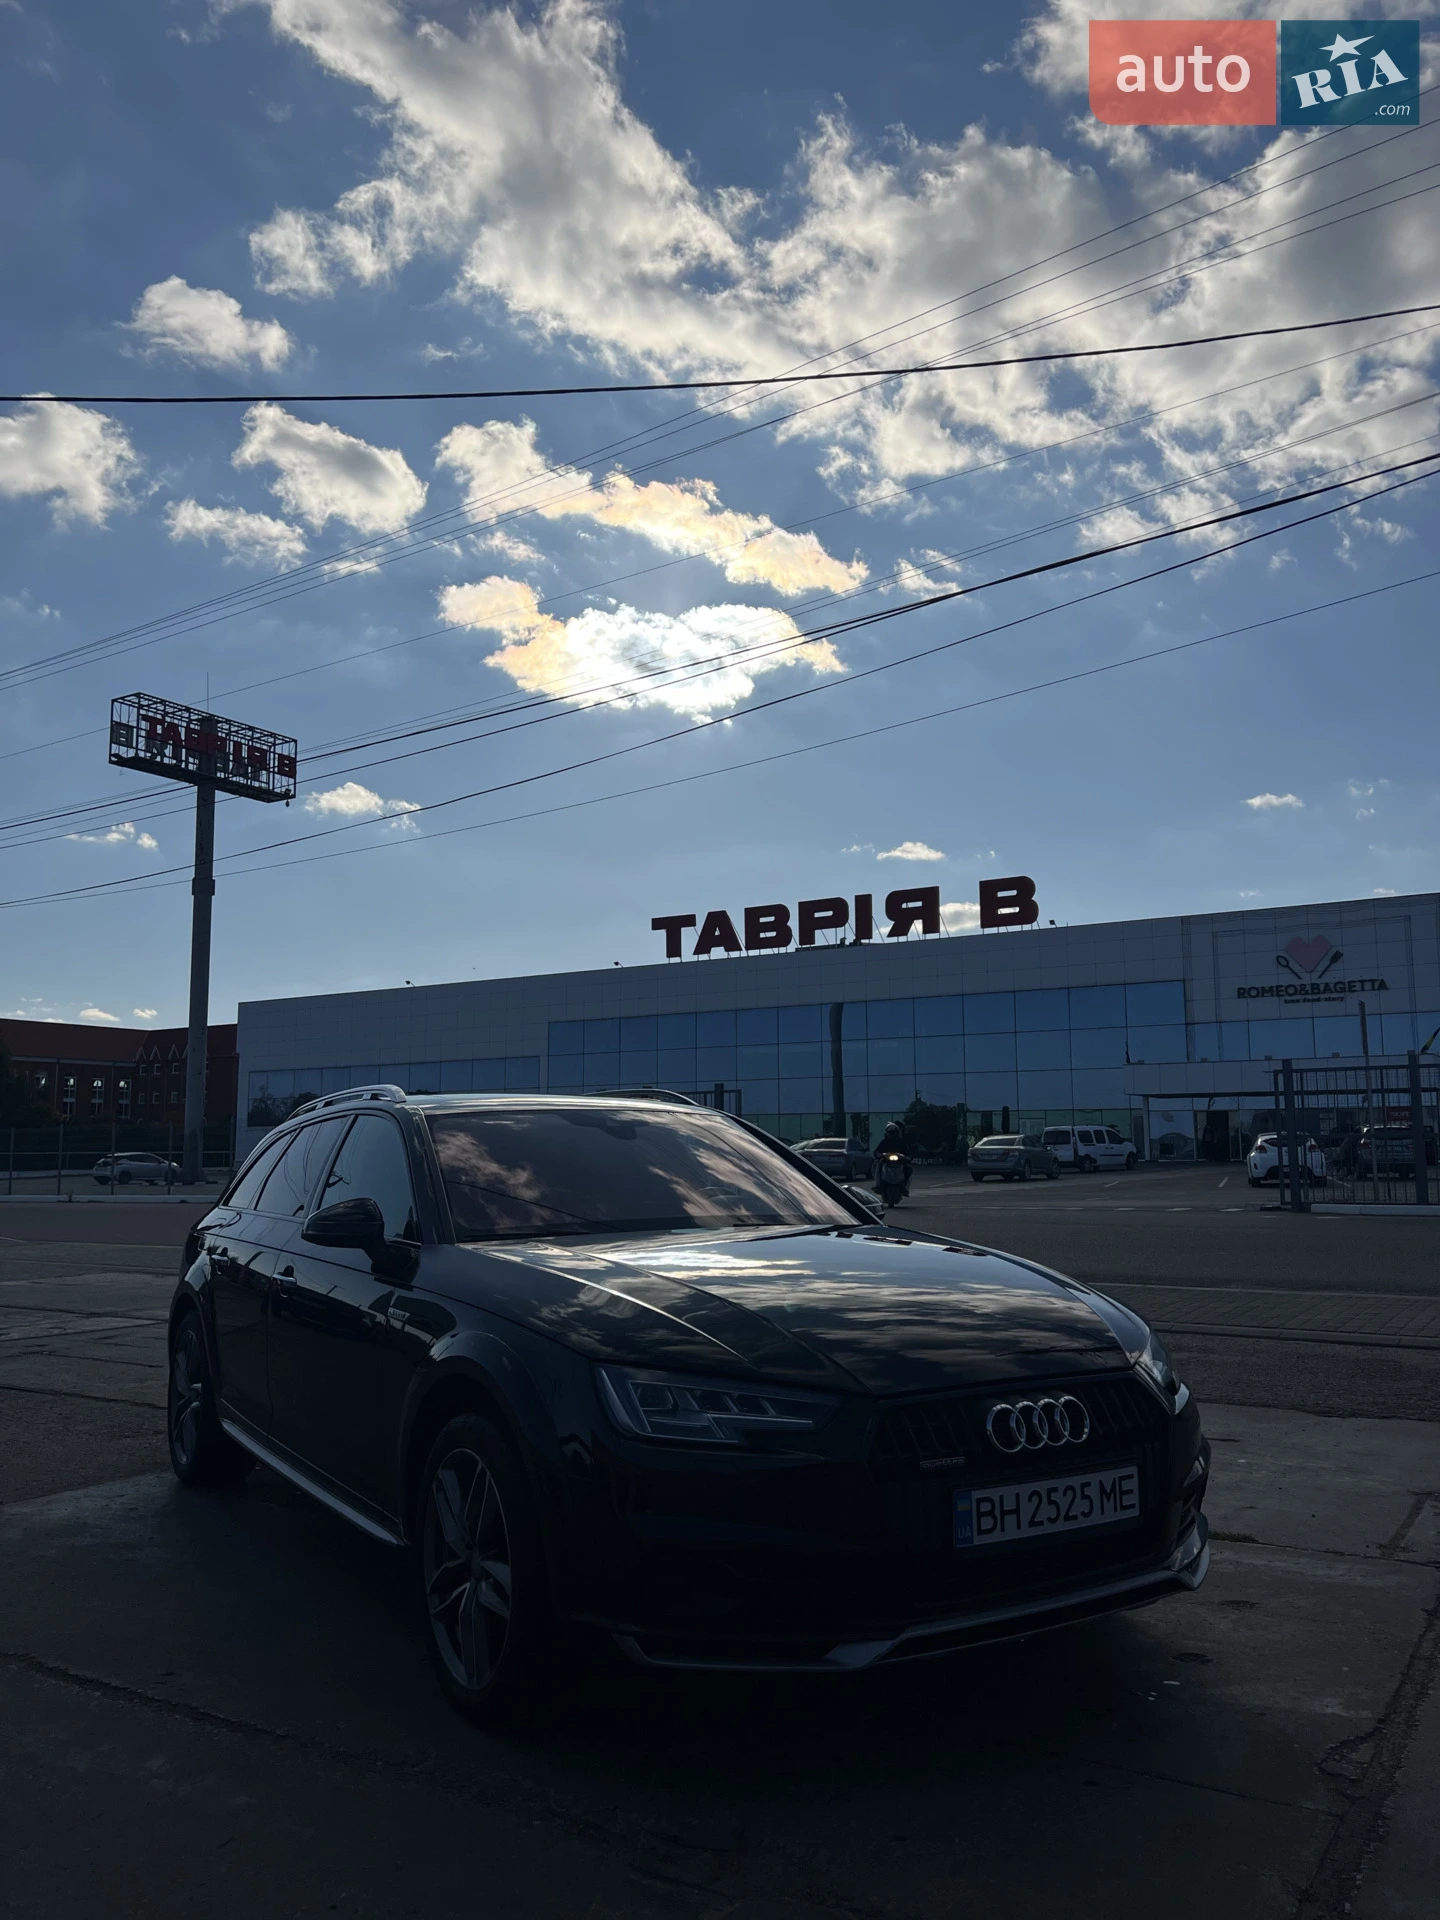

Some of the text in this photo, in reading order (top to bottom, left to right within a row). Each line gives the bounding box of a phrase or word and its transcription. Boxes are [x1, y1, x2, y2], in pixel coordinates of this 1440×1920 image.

[651, 875, 1039, 959] ТАВРІЯ В
[1237, 978, 1389, 999] ROMEO&BAGETTA
[957, 1528, 973, 1540] UA
